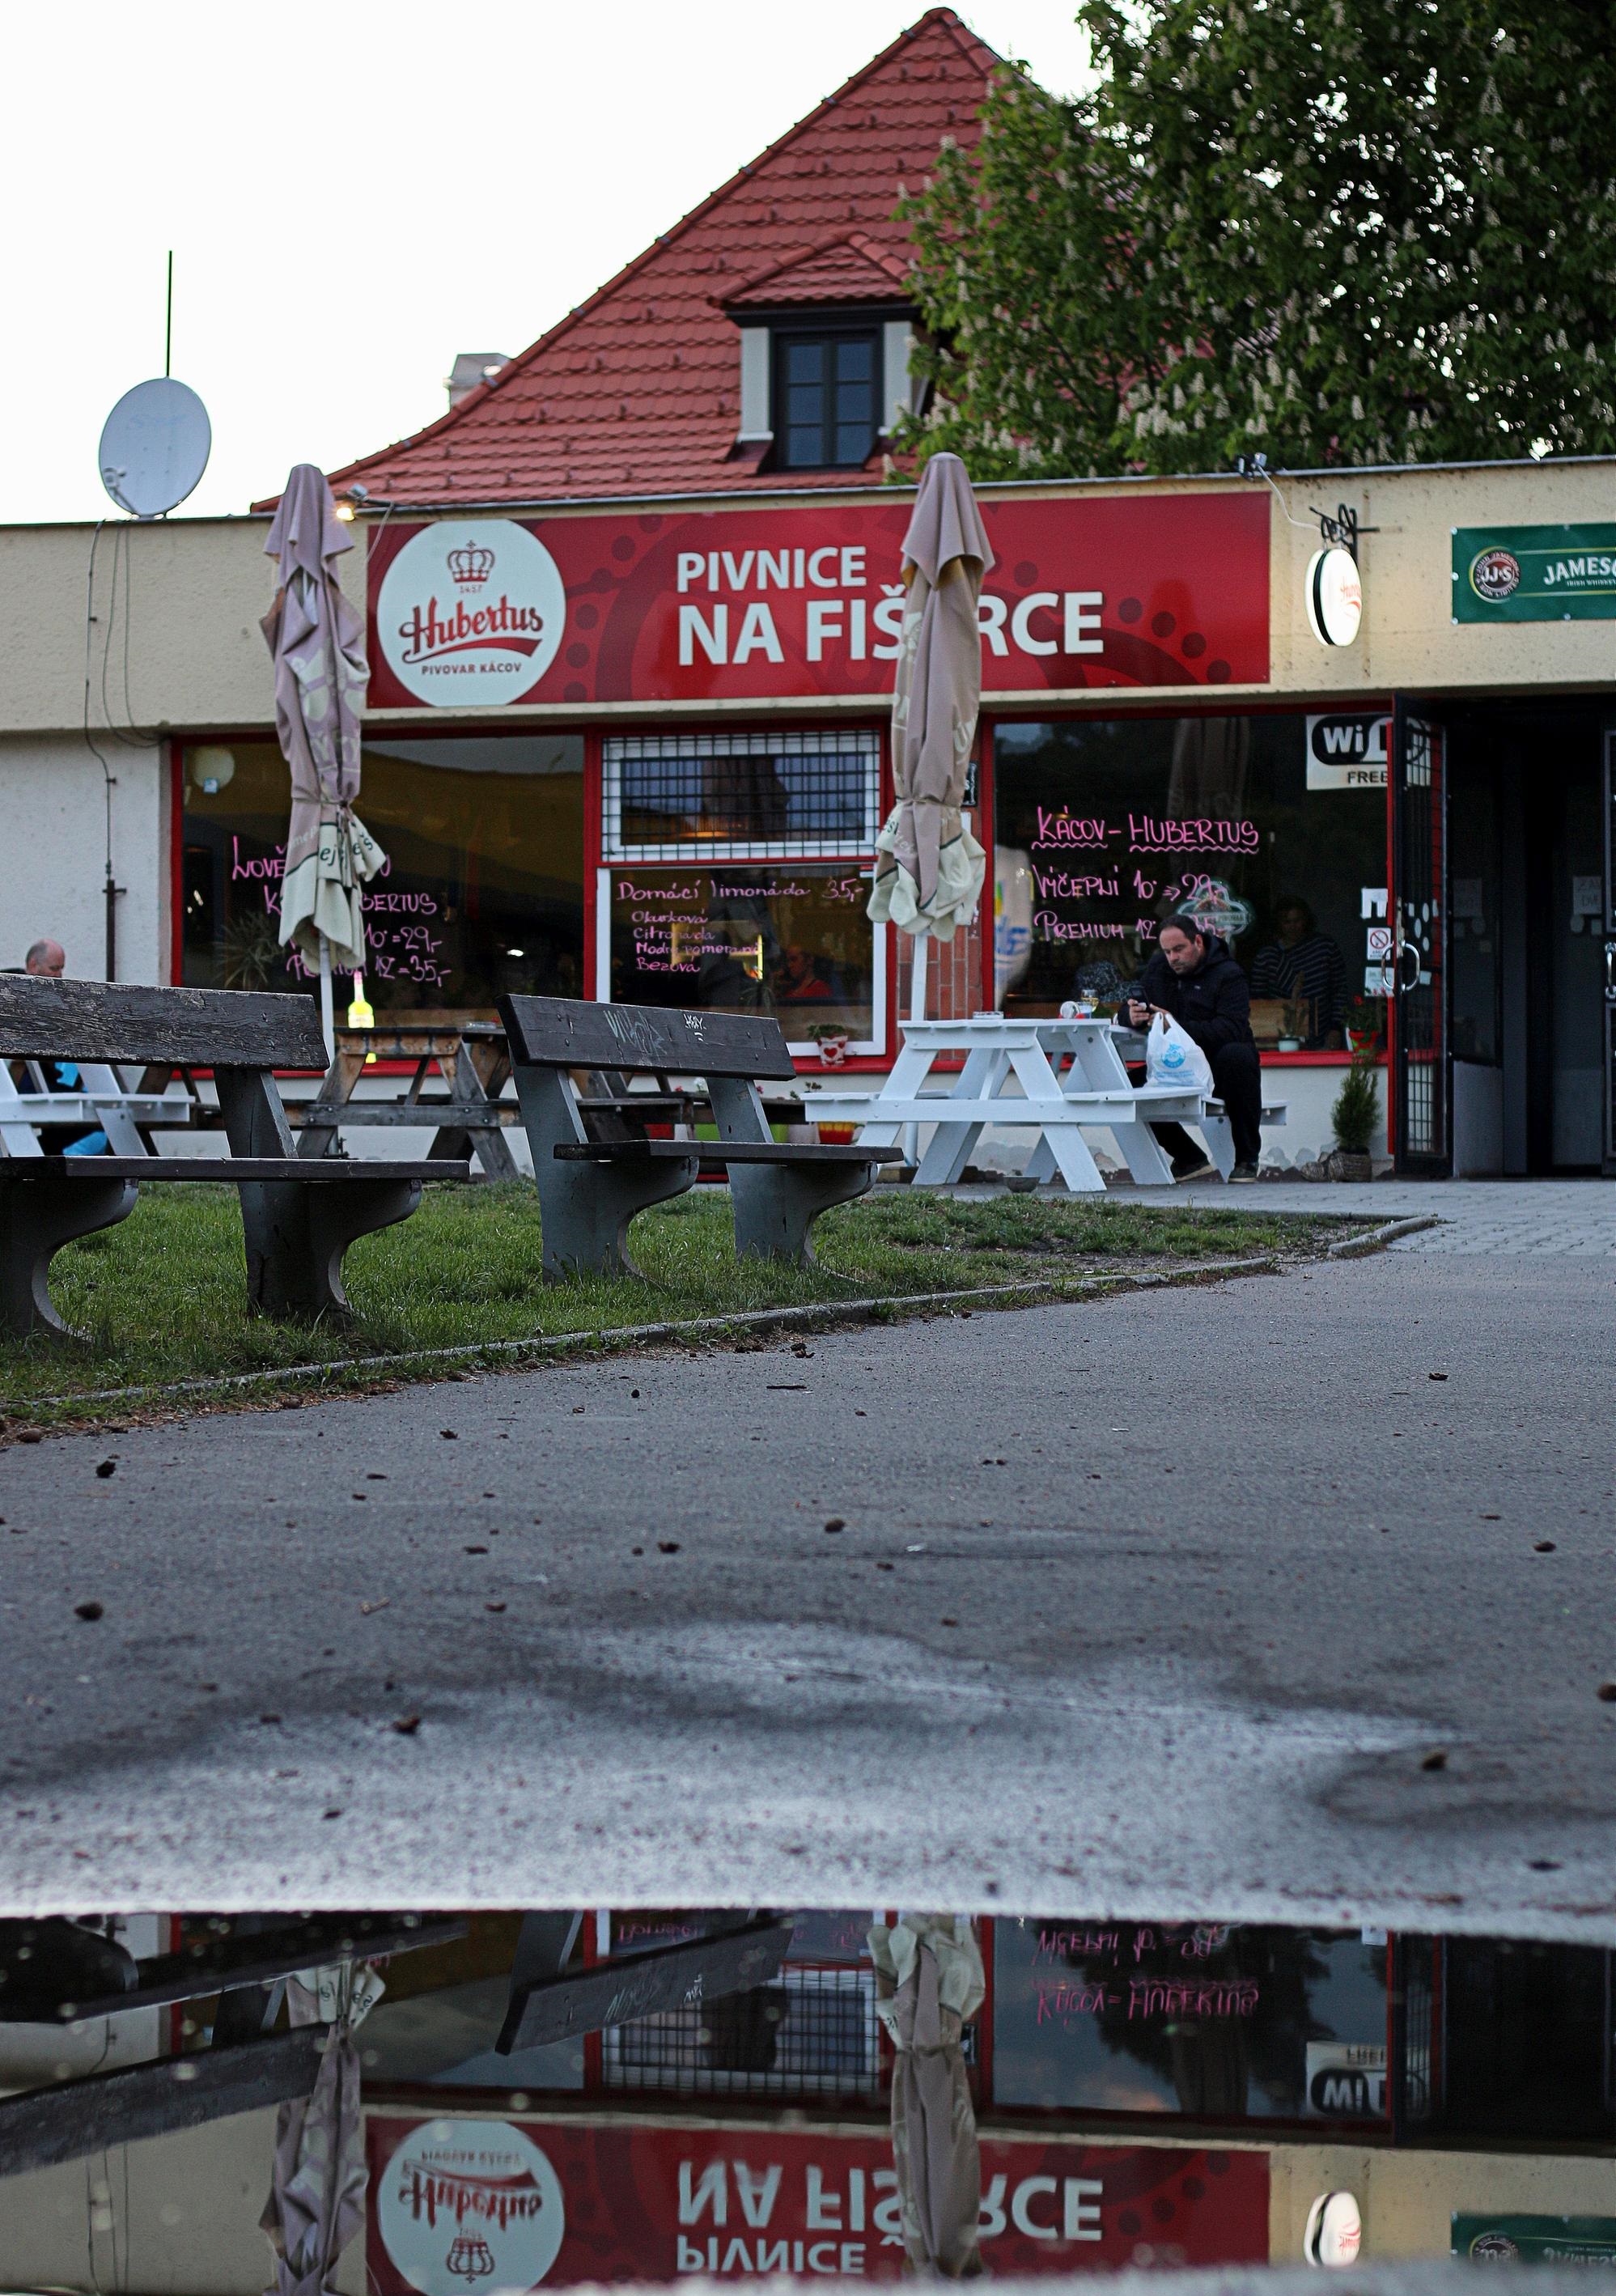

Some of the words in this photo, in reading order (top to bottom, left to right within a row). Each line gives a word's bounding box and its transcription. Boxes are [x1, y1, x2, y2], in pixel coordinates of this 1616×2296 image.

[677, 545, 867, 593] PIVNICE
[398, 594, 544, 655] Hubertus
[678, 602, 786, 666] NA
[806, 583, 1104, 662] FIŠRCE
[421, 664, 476, 676] PIVOVAR
[480, 660, 522, 674] KÁCOV
[1129, 813, 1260, 848] HUBERTUS
